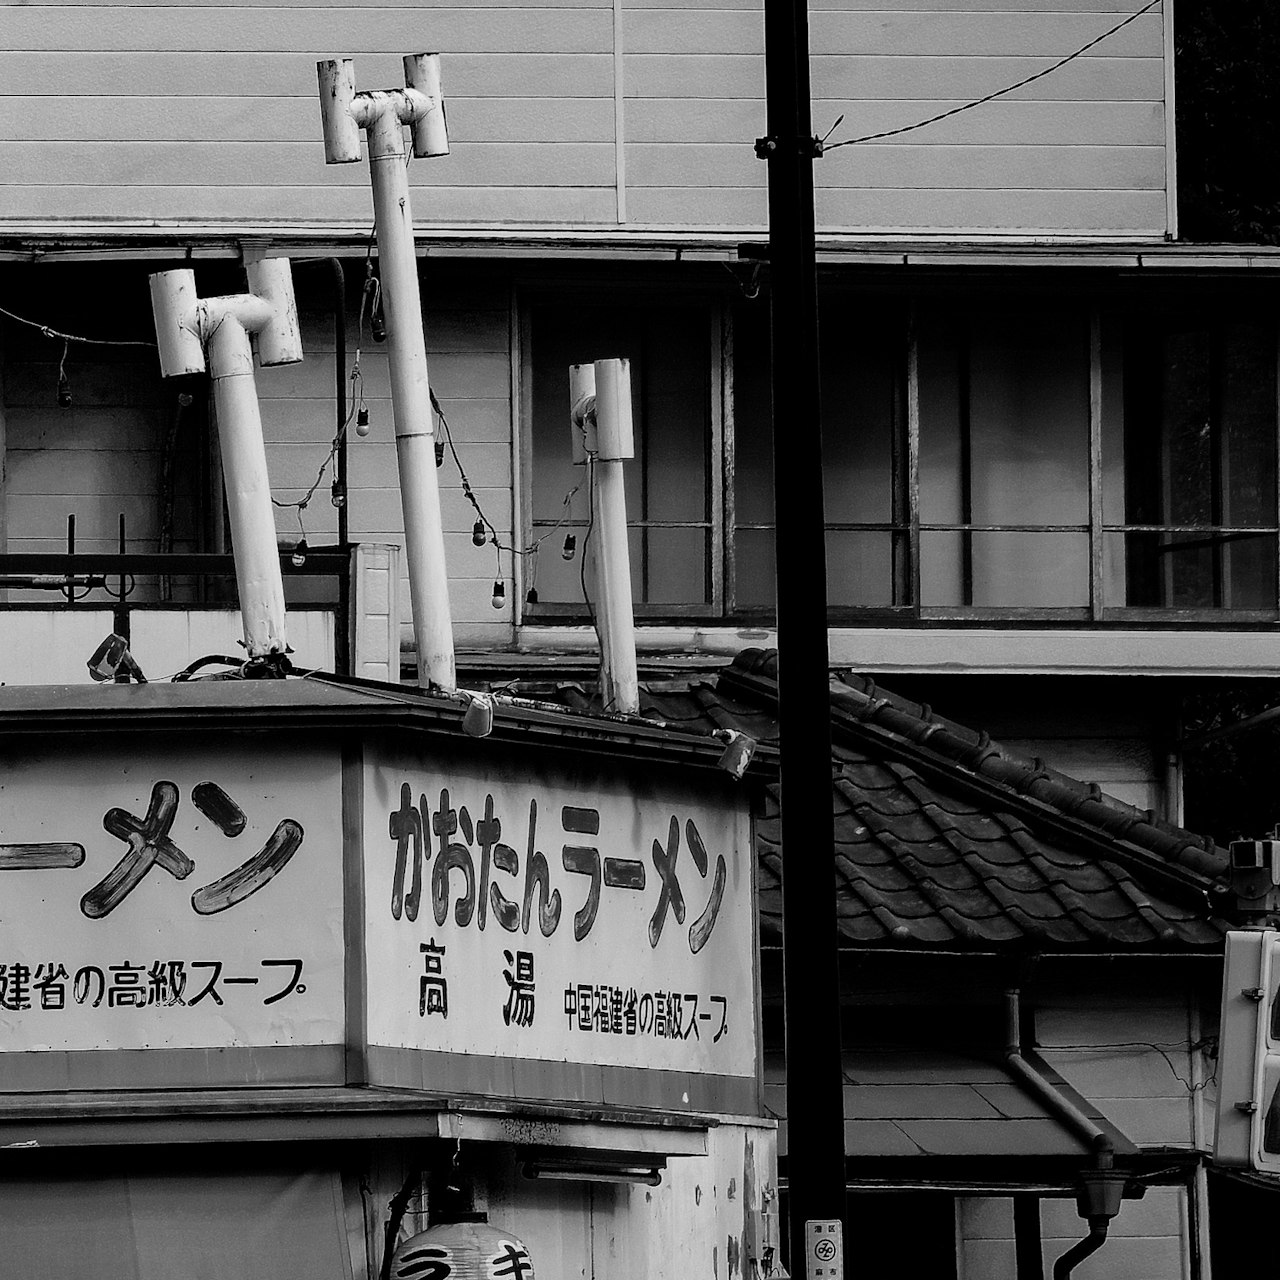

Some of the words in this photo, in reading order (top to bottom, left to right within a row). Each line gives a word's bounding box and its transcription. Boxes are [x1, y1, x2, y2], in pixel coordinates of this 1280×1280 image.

[389, 782, 727, 954] かおたんラーメン
[563, 982, 729, 1044] 中国福建省の高級スープ
